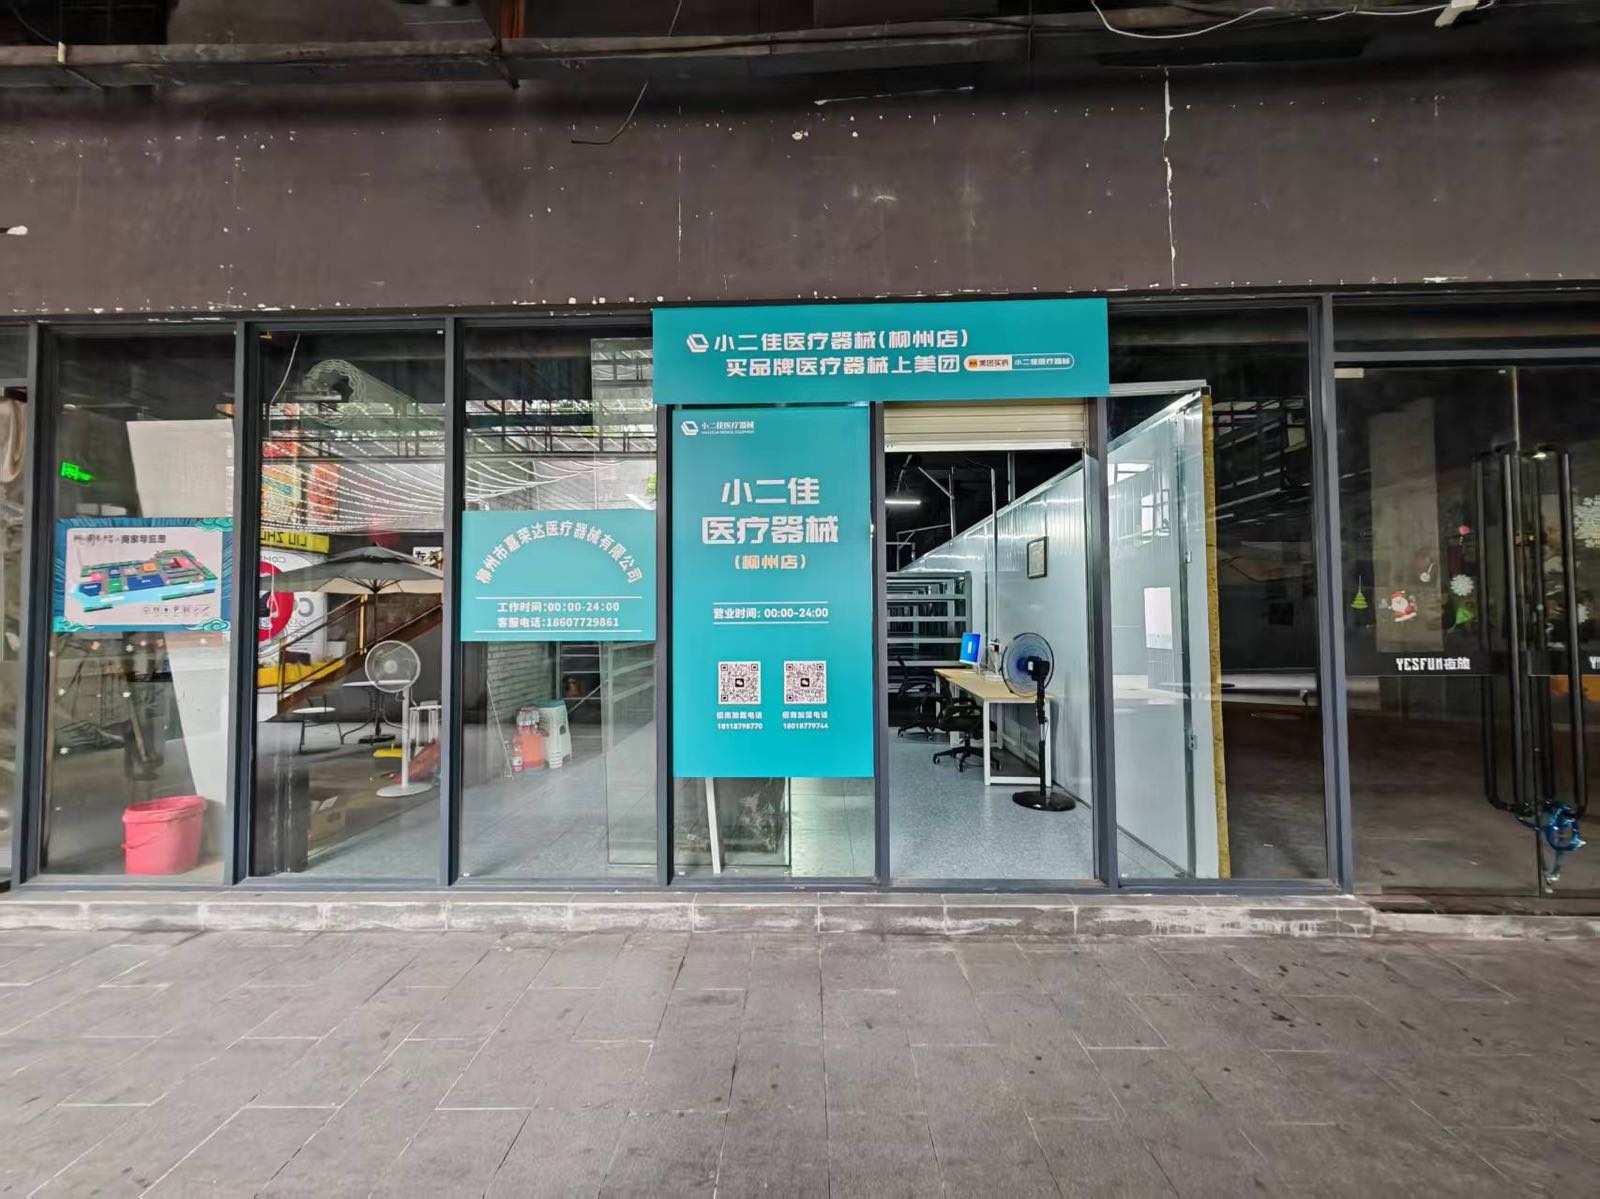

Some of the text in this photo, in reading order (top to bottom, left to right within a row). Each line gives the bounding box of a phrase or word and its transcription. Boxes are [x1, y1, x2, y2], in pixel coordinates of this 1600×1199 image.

[713, 329, 969, 354] 小二佳医疗器械(柳州店)
[726, 354, 961, 378] 买品牌医疗器械上美团
[720, 476, 820, 506] 小二佳
[701, 515, 838, 545] 医疗器械
[734, 554, 807, 569] (柳州店)
